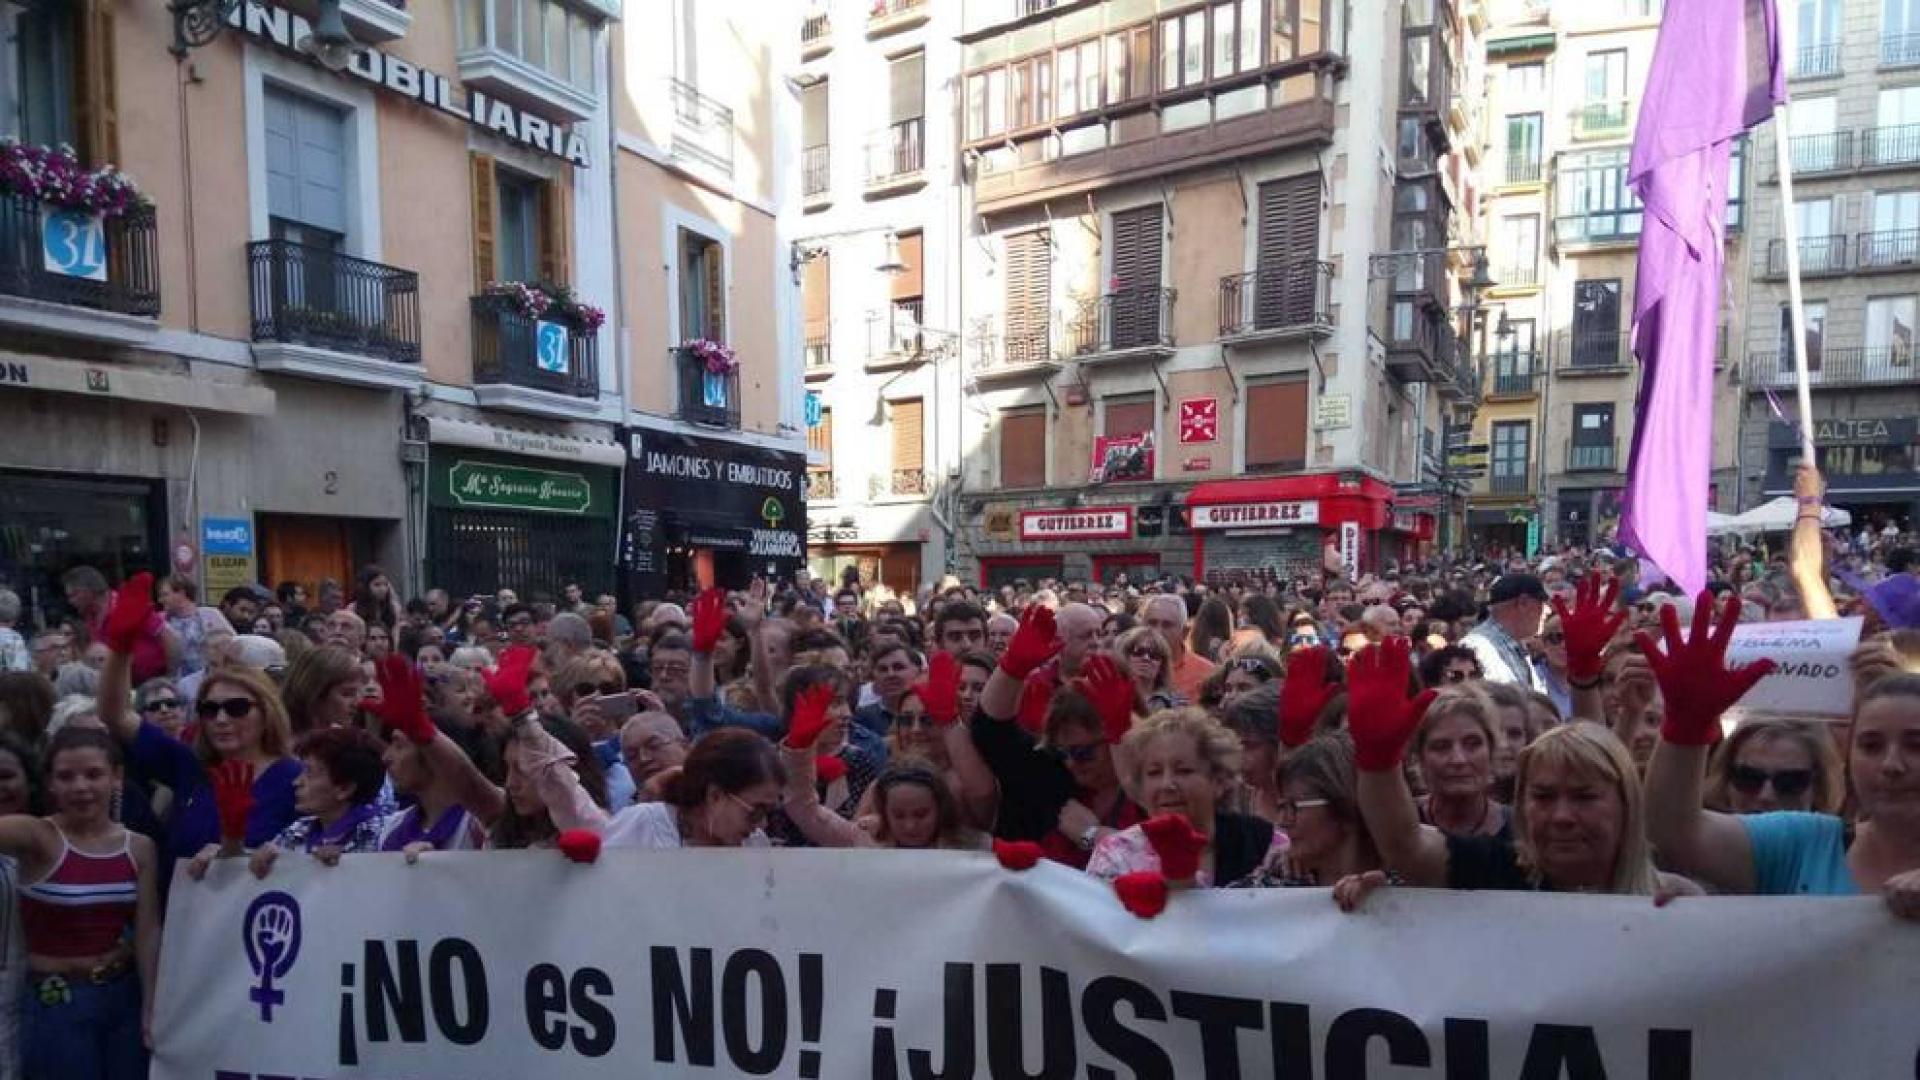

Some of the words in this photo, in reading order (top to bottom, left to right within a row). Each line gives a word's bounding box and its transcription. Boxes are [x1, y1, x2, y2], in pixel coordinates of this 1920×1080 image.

[325, 470, 338, 495] 2
[648, 451, 711, 480] JAMONES
[713, 460, 725, 480] Y
[728, 463, 792, 490] EMBUTIDOS
[1036, 515, 1114, 530] GUTIERREZ
[1209, 504, 1301, 522] GUTIERREZ
[338, 937, 490, 1066] ¡NO
[524, 962, 617, 1058] es
[649, 944, 824, 1080] NO!
